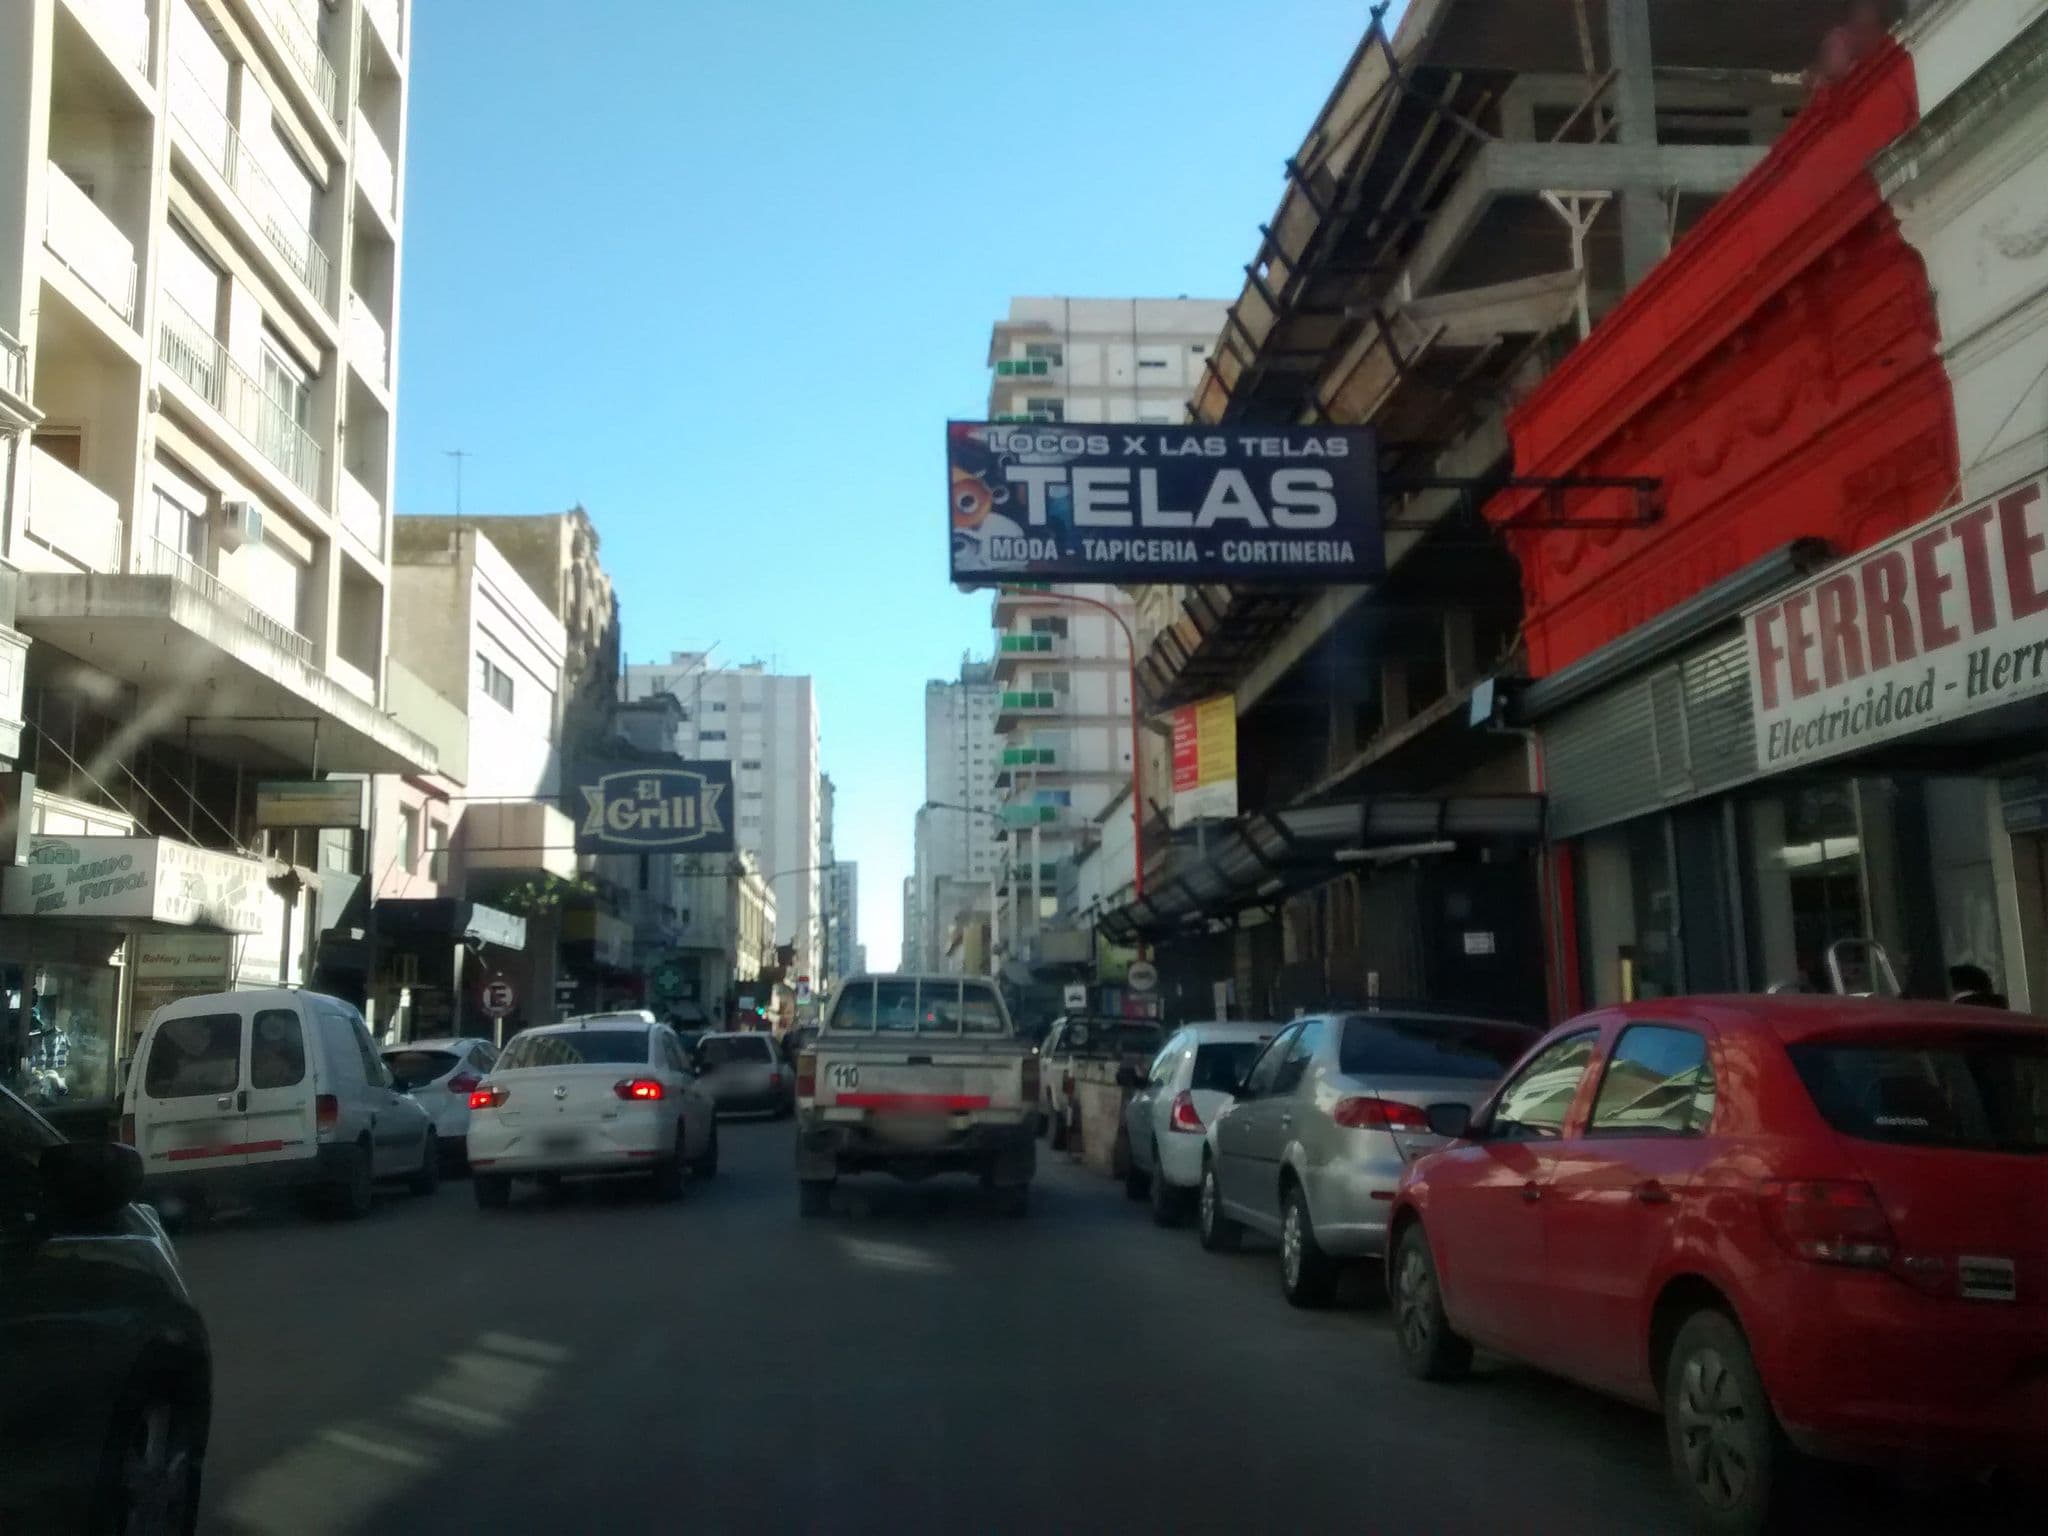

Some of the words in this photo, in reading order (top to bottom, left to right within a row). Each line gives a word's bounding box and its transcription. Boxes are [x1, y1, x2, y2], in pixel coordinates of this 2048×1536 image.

[989, 433, 1110, 456] LOCOS
[1123, 438, 1146, 456] X
[1160, 437, 1228, 457] LAS
[1240, 437, 1350, 458] TELAS
[1005, 466, 1338, 529] TELAS
[991, 537, 1058, 562] MODA
[1081, 539, 1198, 563] TAPICERIA
[1222, 540, 1355, 563] CORTINERIA
[1768, 667, 1935, 762] Electricidad
[633, 780, 661, 800] El
[607, 796, 696, 831] Grill
[66, 854, 133, 885] MUNDO
[79, 872, 148, 904] FUTBOL
[834, 1067, 859, 1089] 110
